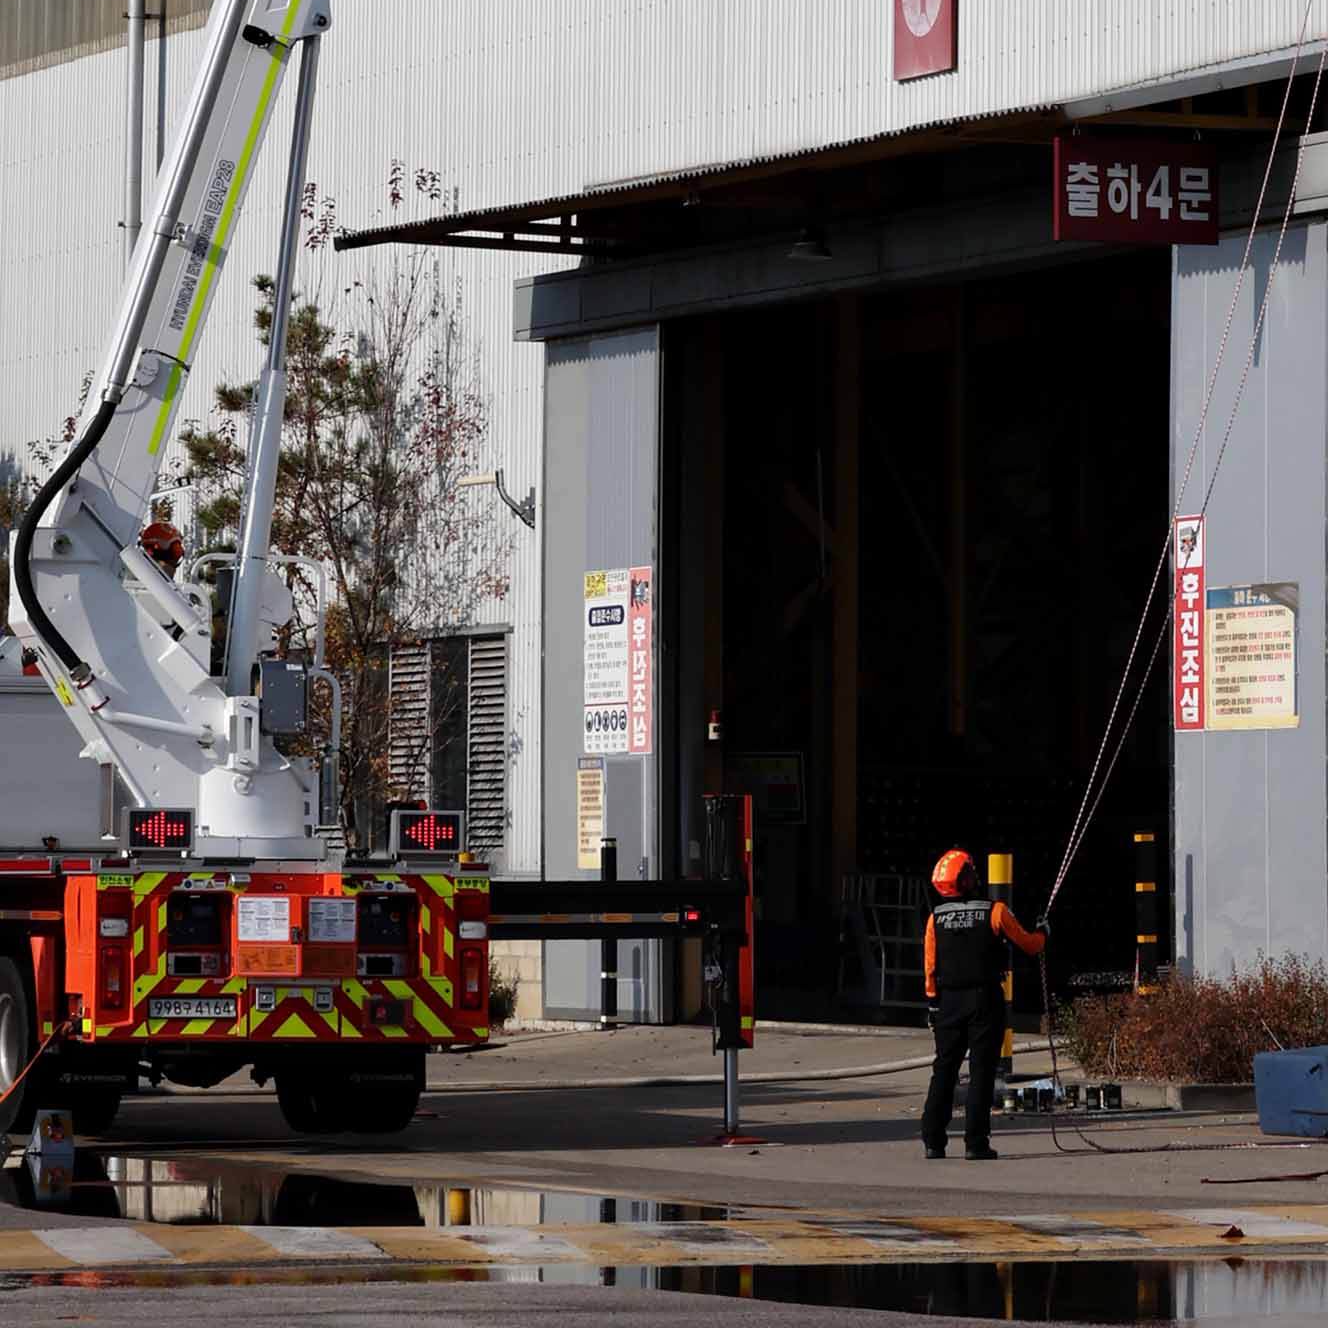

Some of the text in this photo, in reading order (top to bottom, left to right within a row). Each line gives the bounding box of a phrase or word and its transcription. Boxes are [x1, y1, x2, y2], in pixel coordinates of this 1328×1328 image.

[169, 274, 197, 331] HYUNDAI
[205, 159, 235, 214] EAP28
[1065, 162, 1212, 221] 출하4문
[632, 617, 646, 746] 후진조심
[1180, 573, 1199, 722] 후진조심
[944, 920, 973, 929] RESCUE
